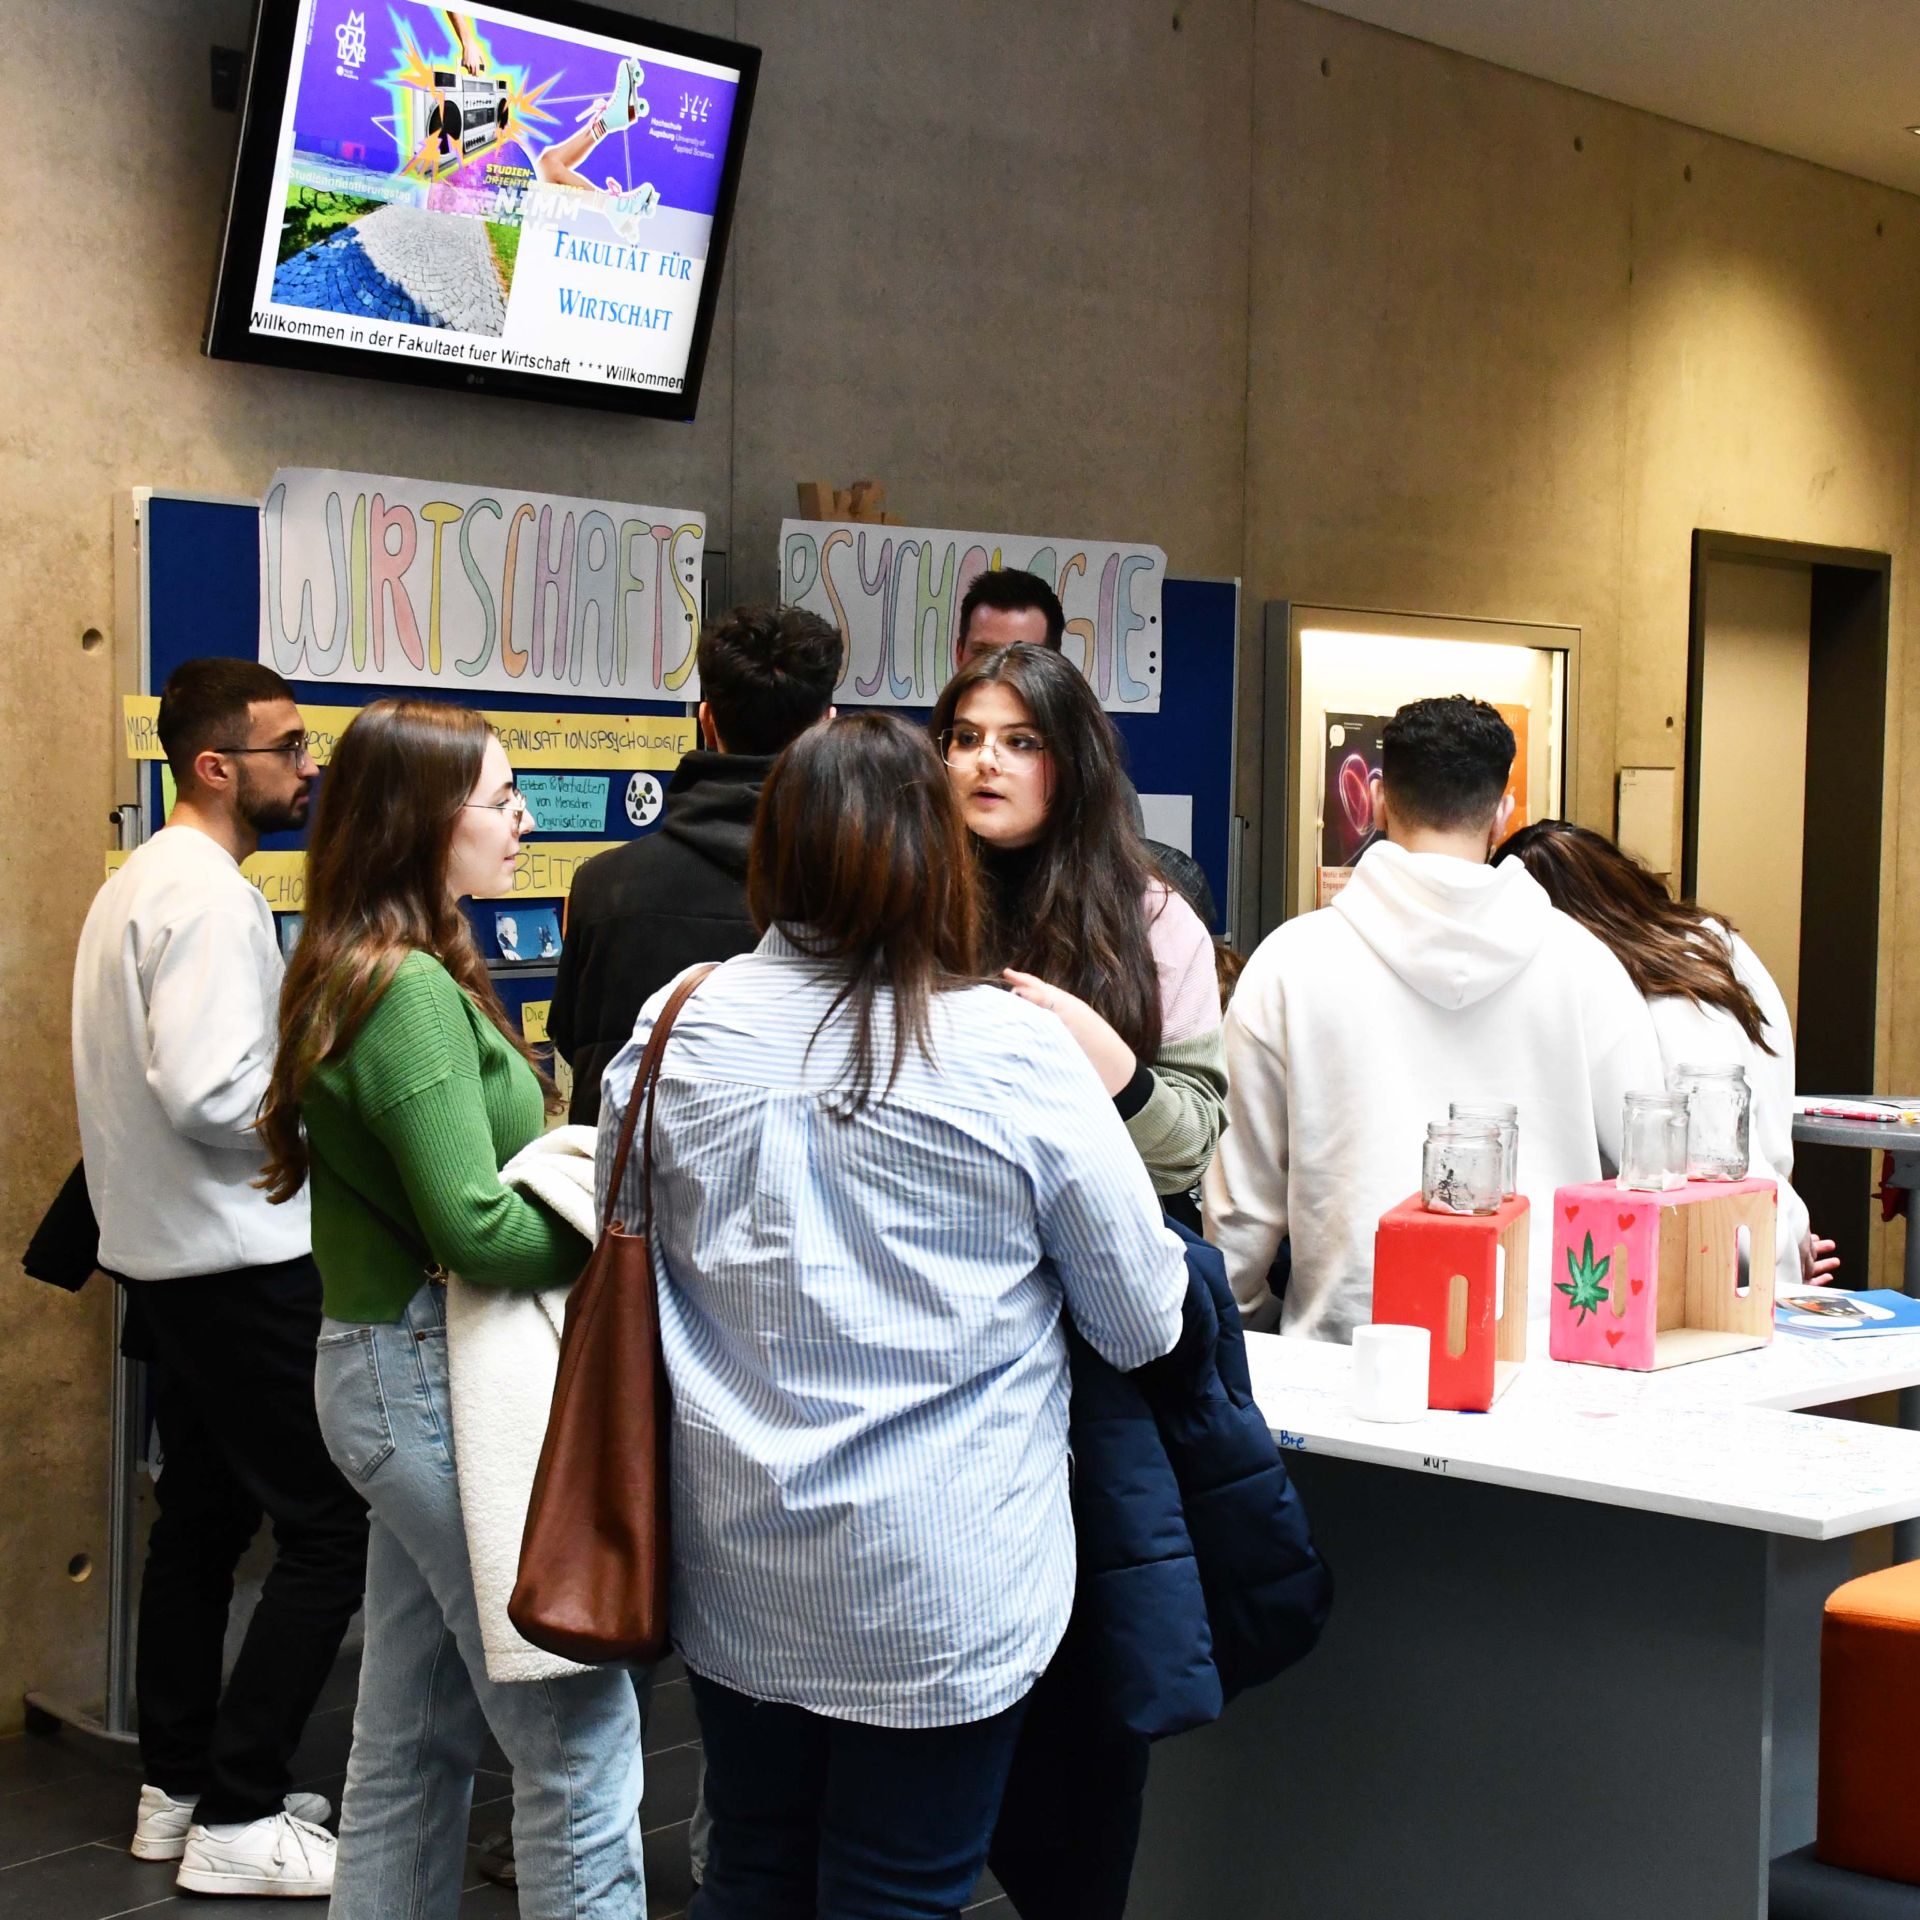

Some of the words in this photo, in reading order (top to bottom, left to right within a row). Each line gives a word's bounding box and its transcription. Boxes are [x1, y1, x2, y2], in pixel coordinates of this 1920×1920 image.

[485, 163, 534, 177] STUDIEN-
[249, 311, 345, 341] Willkommen
[350, 326, 364, 343] in
[368, 329, 394, 348] der
[397, 333, 465, 359] Fakultaet
[468, 344, 497, 363] fuer
[501, 348, 571, 374] Wirtschaft
[605, 364, 685, 390] Willkommen
[265, 483, 703, 691] WIRTSCHAFTS
[524, 1006, 545, 1023] Die
[1423, 1456, 1449, 1473] MUT
